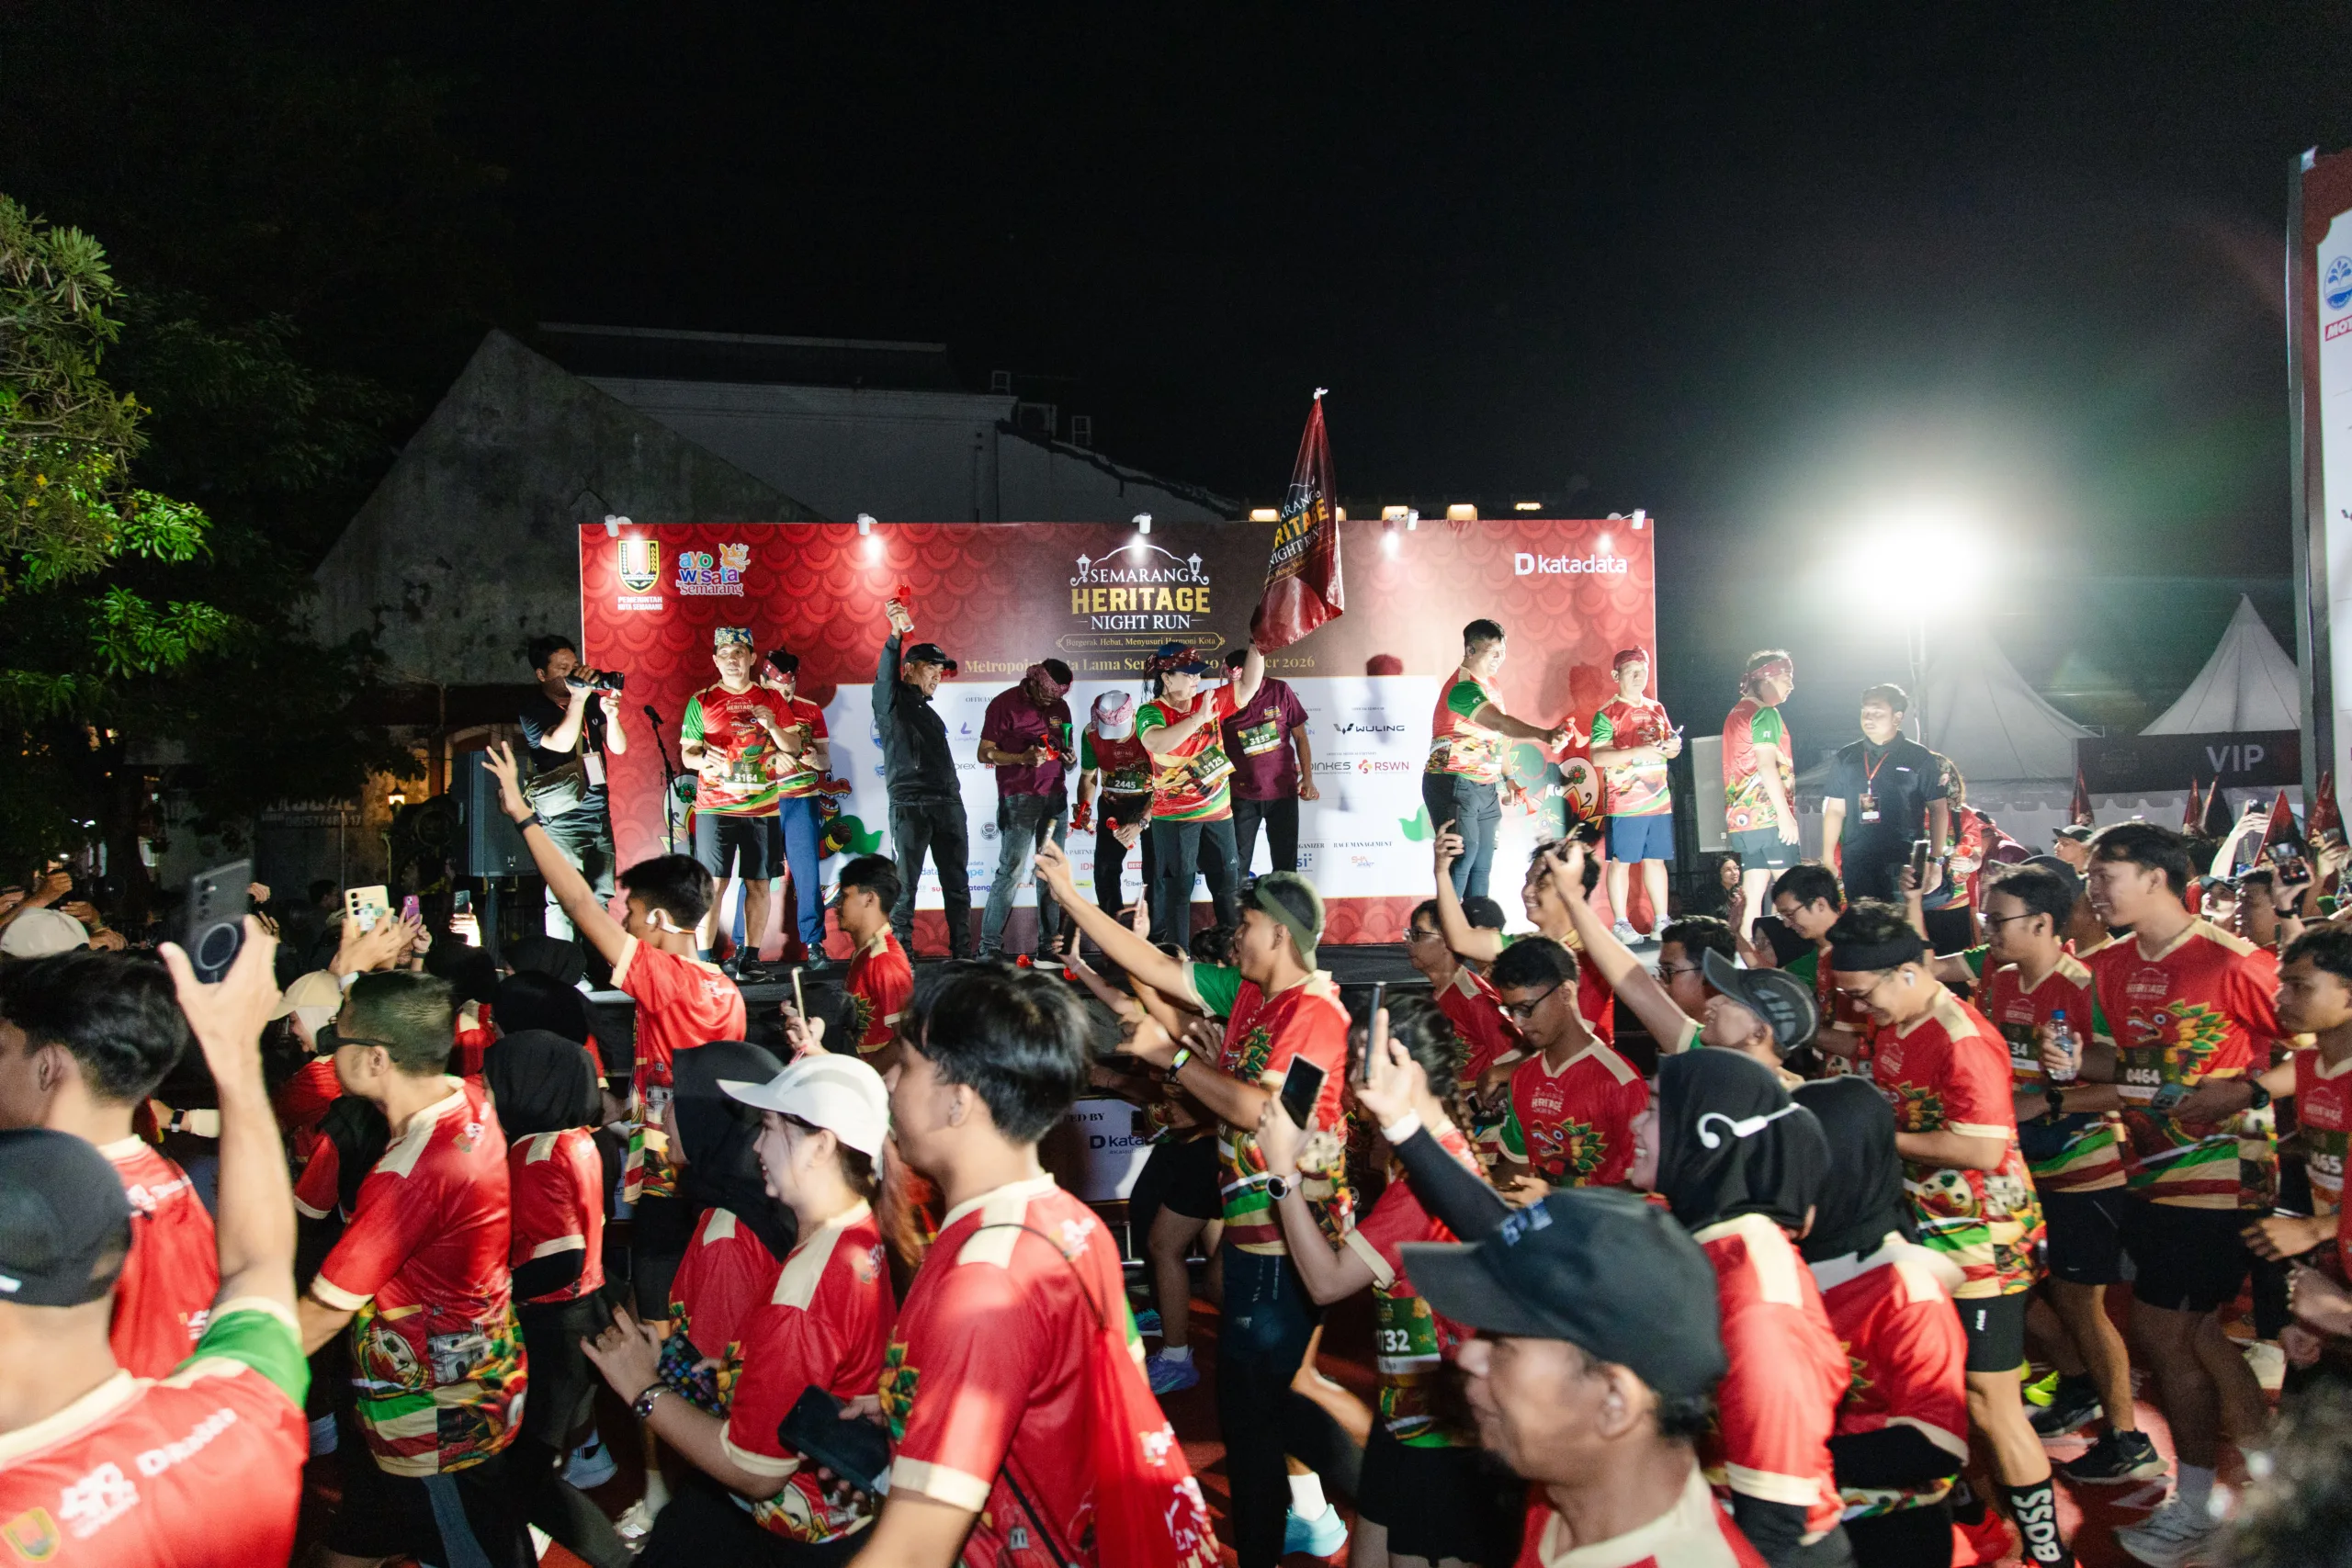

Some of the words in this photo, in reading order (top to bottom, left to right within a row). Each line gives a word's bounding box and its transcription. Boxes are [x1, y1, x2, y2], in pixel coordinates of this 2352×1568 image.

[680, 551, 713, 572] ayo
[1538, 555, 1627, 573] katadata
[680, 566, 740, 585] wisata
[1091, 568, 1189, 583] SEMARANG
[680, 581, 744, 596] semarang
[1071, 587, 1210, 615] HERITAGE
[1091, 615, 1148, 630] NIGHT
[1152, 615, 1191, 629] RUN
[1066, 638, 1098, 648] Bergerak
[1100, 638, 1124, 647] Hebat,
[1125, 637, 1164, 648] Menyusuri
[1083, 660, 1121, 671] Lama
[1283, 658, 1316, 669] 2026
[1250, 734, 1271, 746] 3133
[1203, 756, 1225, 773] 3125
[1374, 761, 1409, 771] RSWN
[2206, 745, 2265, 773] VIP
[735, 773, 758, 783] 3164
[1114, 779, 1136, 789] 2445
[1090, 1112, 1105, 1122] BY
[2011, 1488, 2062, 1562] BOSS
